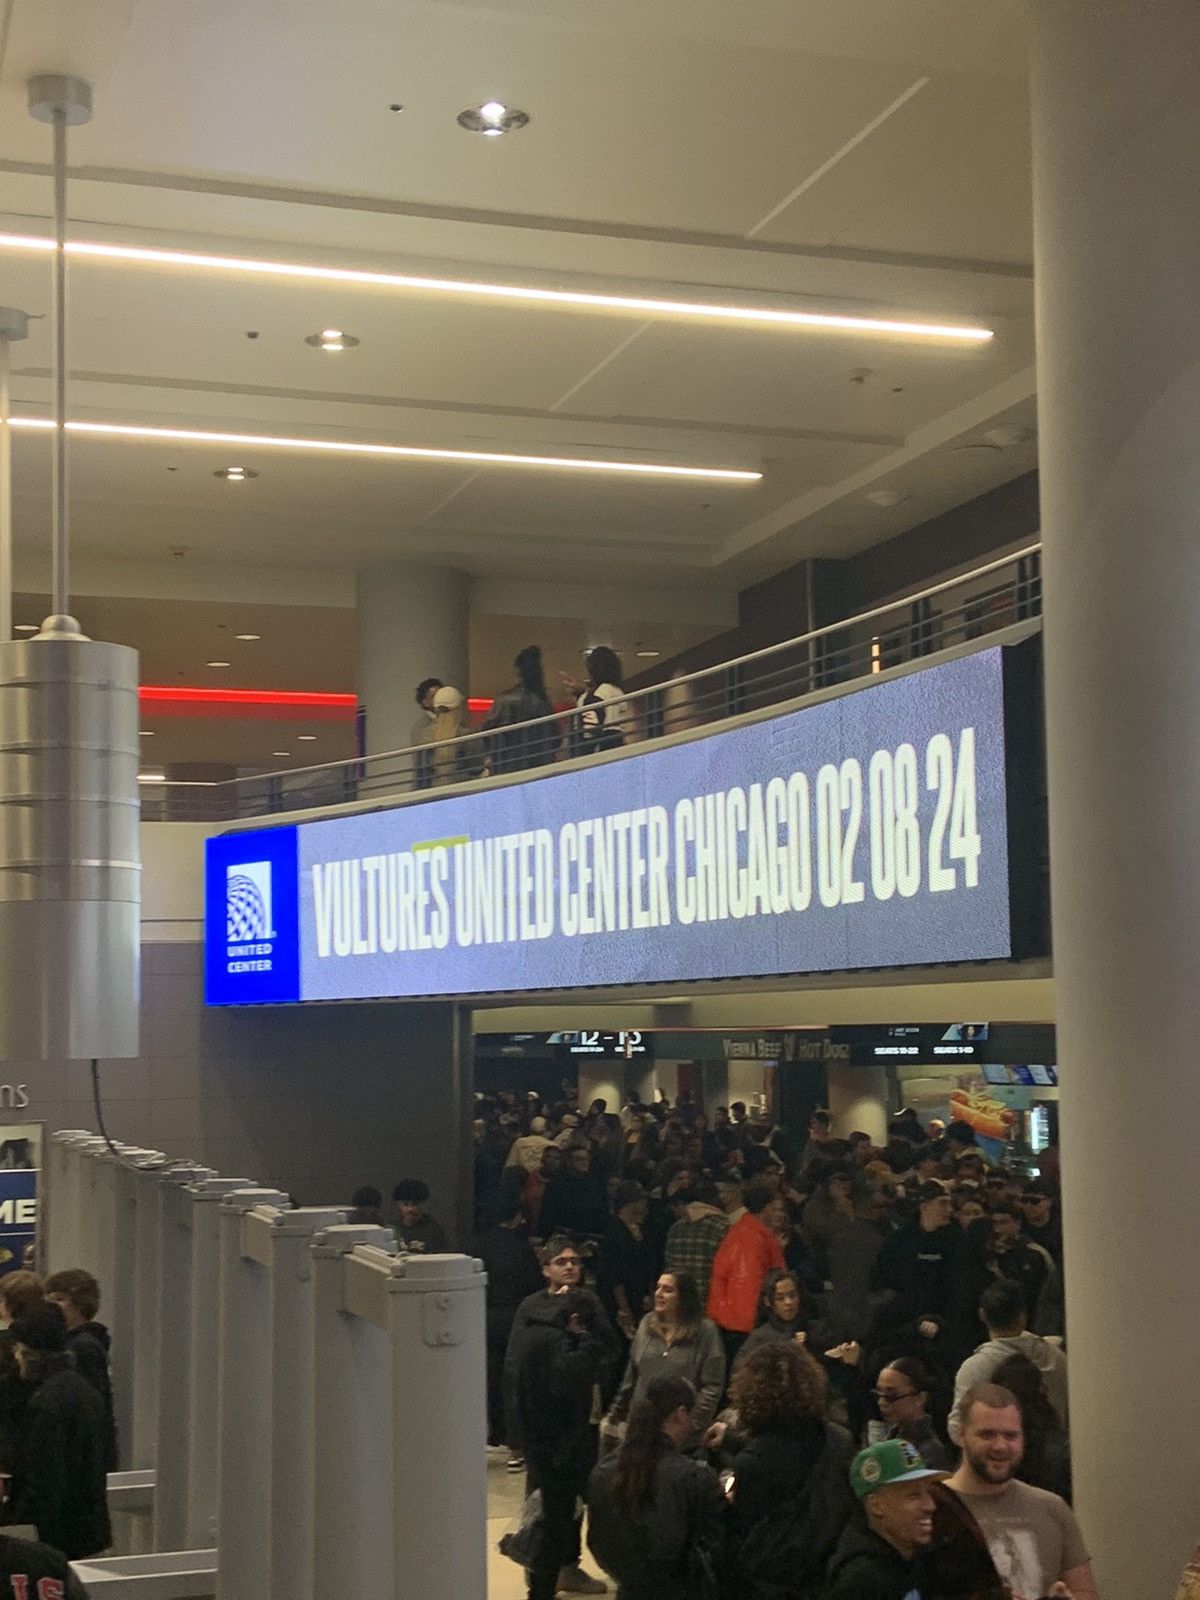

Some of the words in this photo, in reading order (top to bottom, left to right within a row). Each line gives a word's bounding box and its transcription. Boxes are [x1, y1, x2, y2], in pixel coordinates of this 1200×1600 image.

[312, 846, 450, 958] VULTURES
[454, 828, 554, 947] UNITED
[560, 805, 671, 937] CENTER
[675, 771, 812, 925] CHICAGO
[816, 757, 865, 909] 02
[869, 743, 921, 901] 08
[926, 727, 982, 893] 24
[227, 943, 273, 957] UNITED
[227, 959, 273, 973] CENTER
